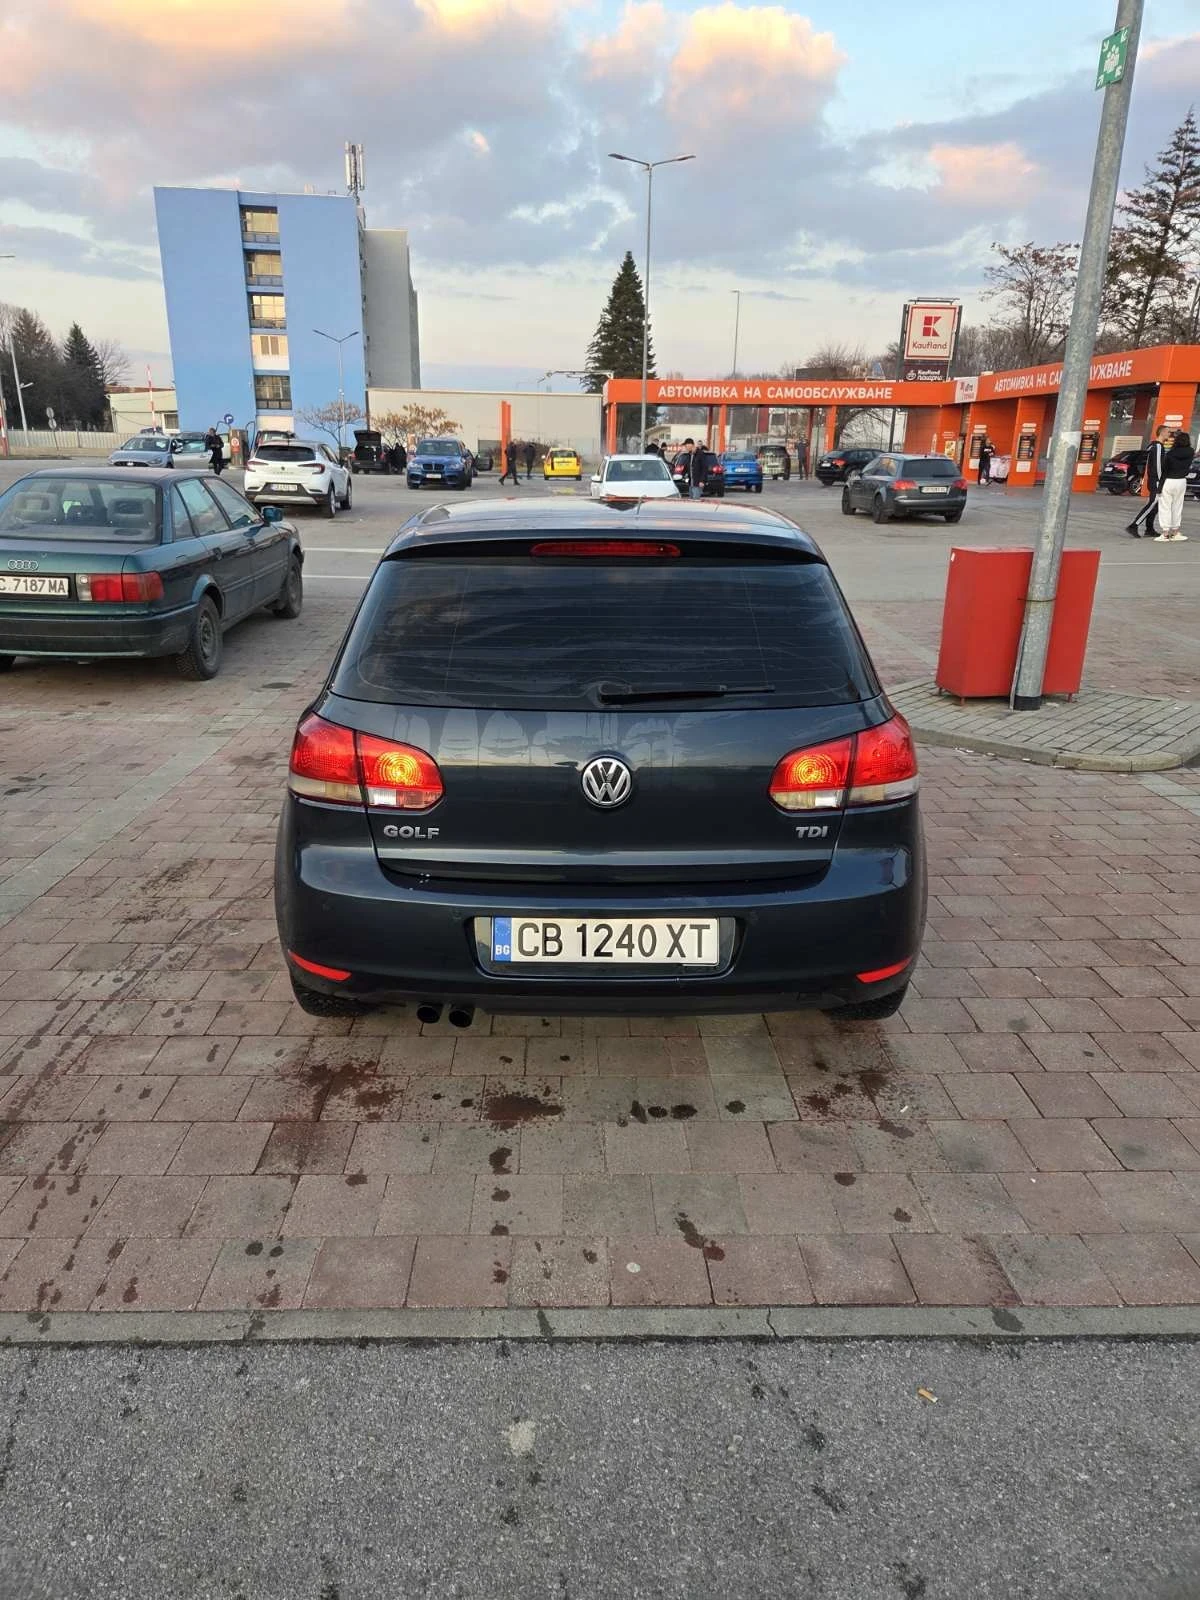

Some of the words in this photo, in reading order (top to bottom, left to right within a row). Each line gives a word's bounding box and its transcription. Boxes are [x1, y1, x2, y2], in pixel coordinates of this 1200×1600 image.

[912, 341, 948, 350] Kaufland
[993, 375, 1034, 393] АВТОМИВКА
[1036, 374, 1047, 388] НА
[658, 385, 738, 398] АВТОМИВКА
[743, 386, 762, 398] НА
[767, 386, 893, 399] САМООБСЛУЖВАНЕ
[13, 578, 46, 592] 7187
[48, 579, 66, 593] MA
[383, 824, 440, 839] GOLF
[795, 825, 828, 839] TDI
[517, 922, 563, 957] CB
[576, 923, 657, 958] 1240
[666, 923, 710, 958] XT
[495, 945, 510, 955] BG
